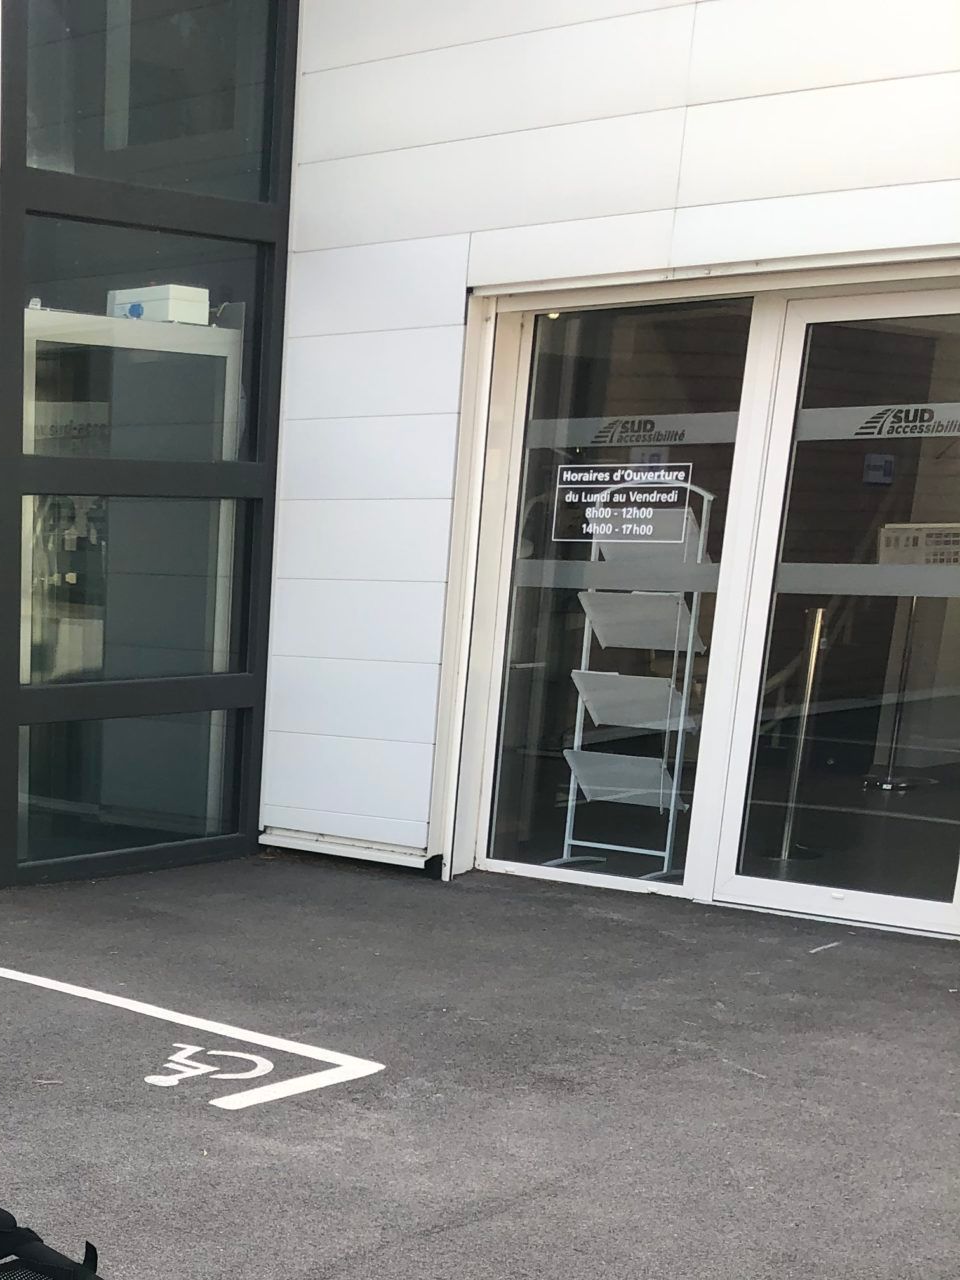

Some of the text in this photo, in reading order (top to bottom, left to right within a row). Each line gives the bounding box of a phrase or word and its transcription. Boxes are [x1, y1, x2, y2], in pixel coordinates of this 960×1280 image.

[890, 408, 935, 424] SUD
[620, 419, 656, 434] SUD
[616, 429, 686, 444] accessibilité
[562, 469, 686, 482] Horaires d'Ouverture
[565, 490, 679, 503] du Lundi au Vendredi
[585, 507, 611, 519] 8h00
[622, 507, 654, 519] 12h00
[582, 523, 613, 535] 14h00
[622, 524, 654, 536] 17h00
